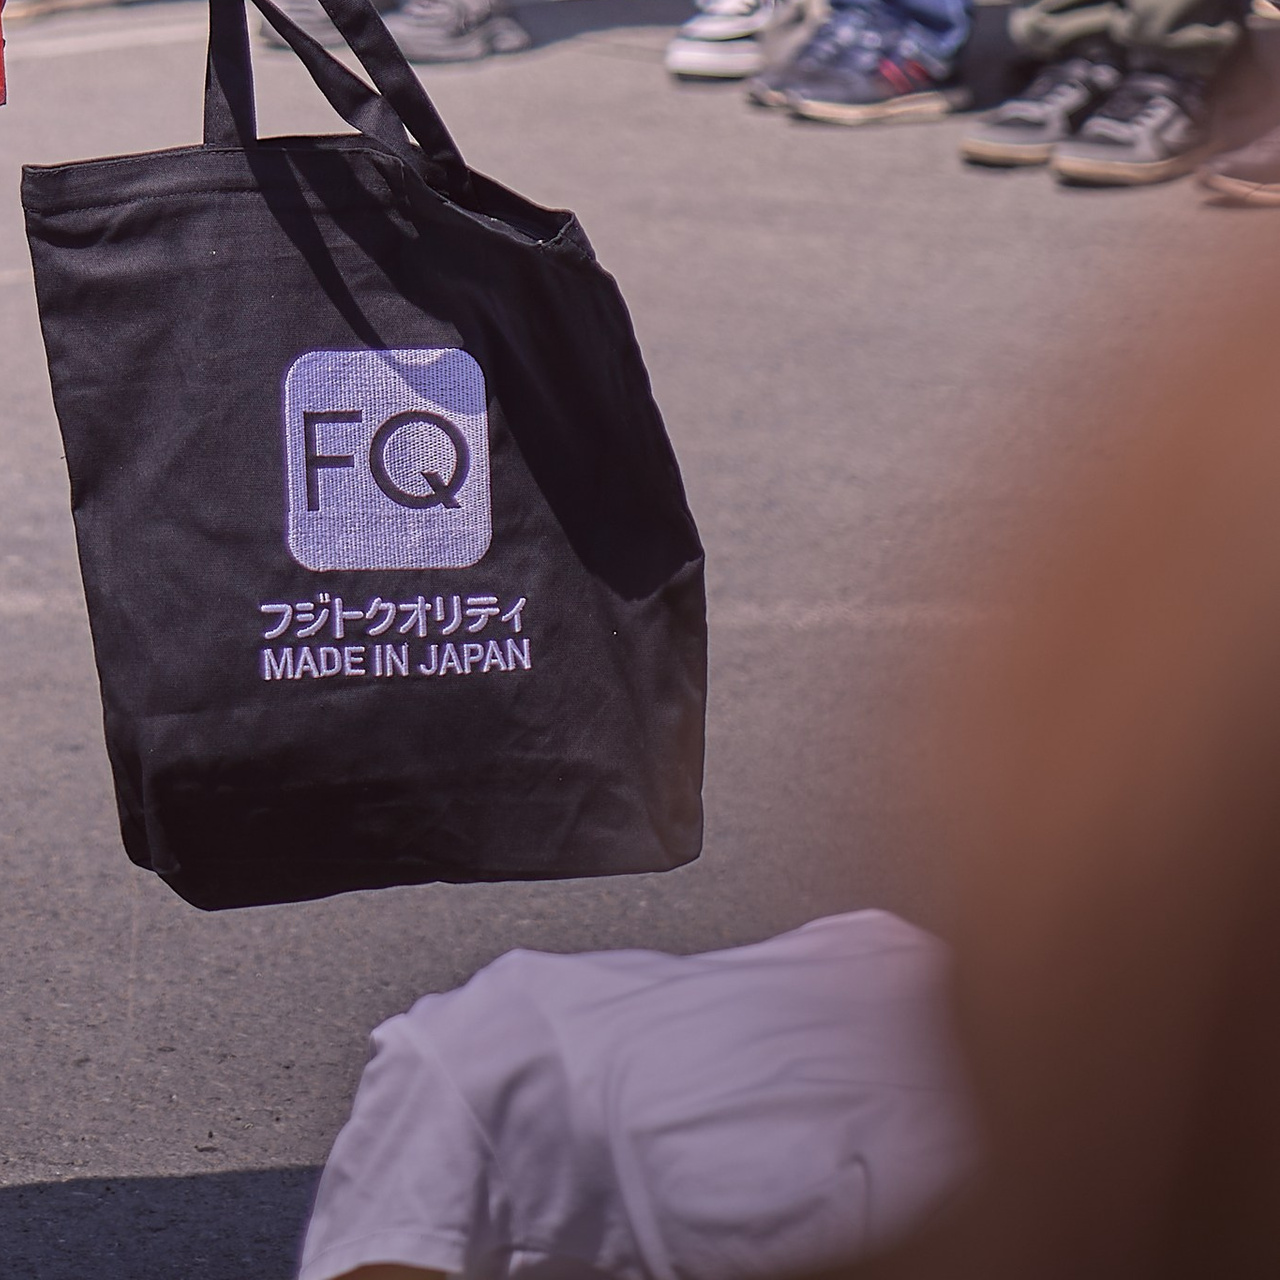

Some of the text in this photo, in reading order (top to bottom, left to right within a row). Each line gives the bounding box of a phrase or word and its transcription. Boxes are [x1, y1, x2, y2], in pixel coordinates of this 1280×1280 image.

[303, 409, 470, 512] FQ
[261, 592, 527, 640] フジトクオリティ
[263, 638, 532, 681] MADE IN JAPAN
